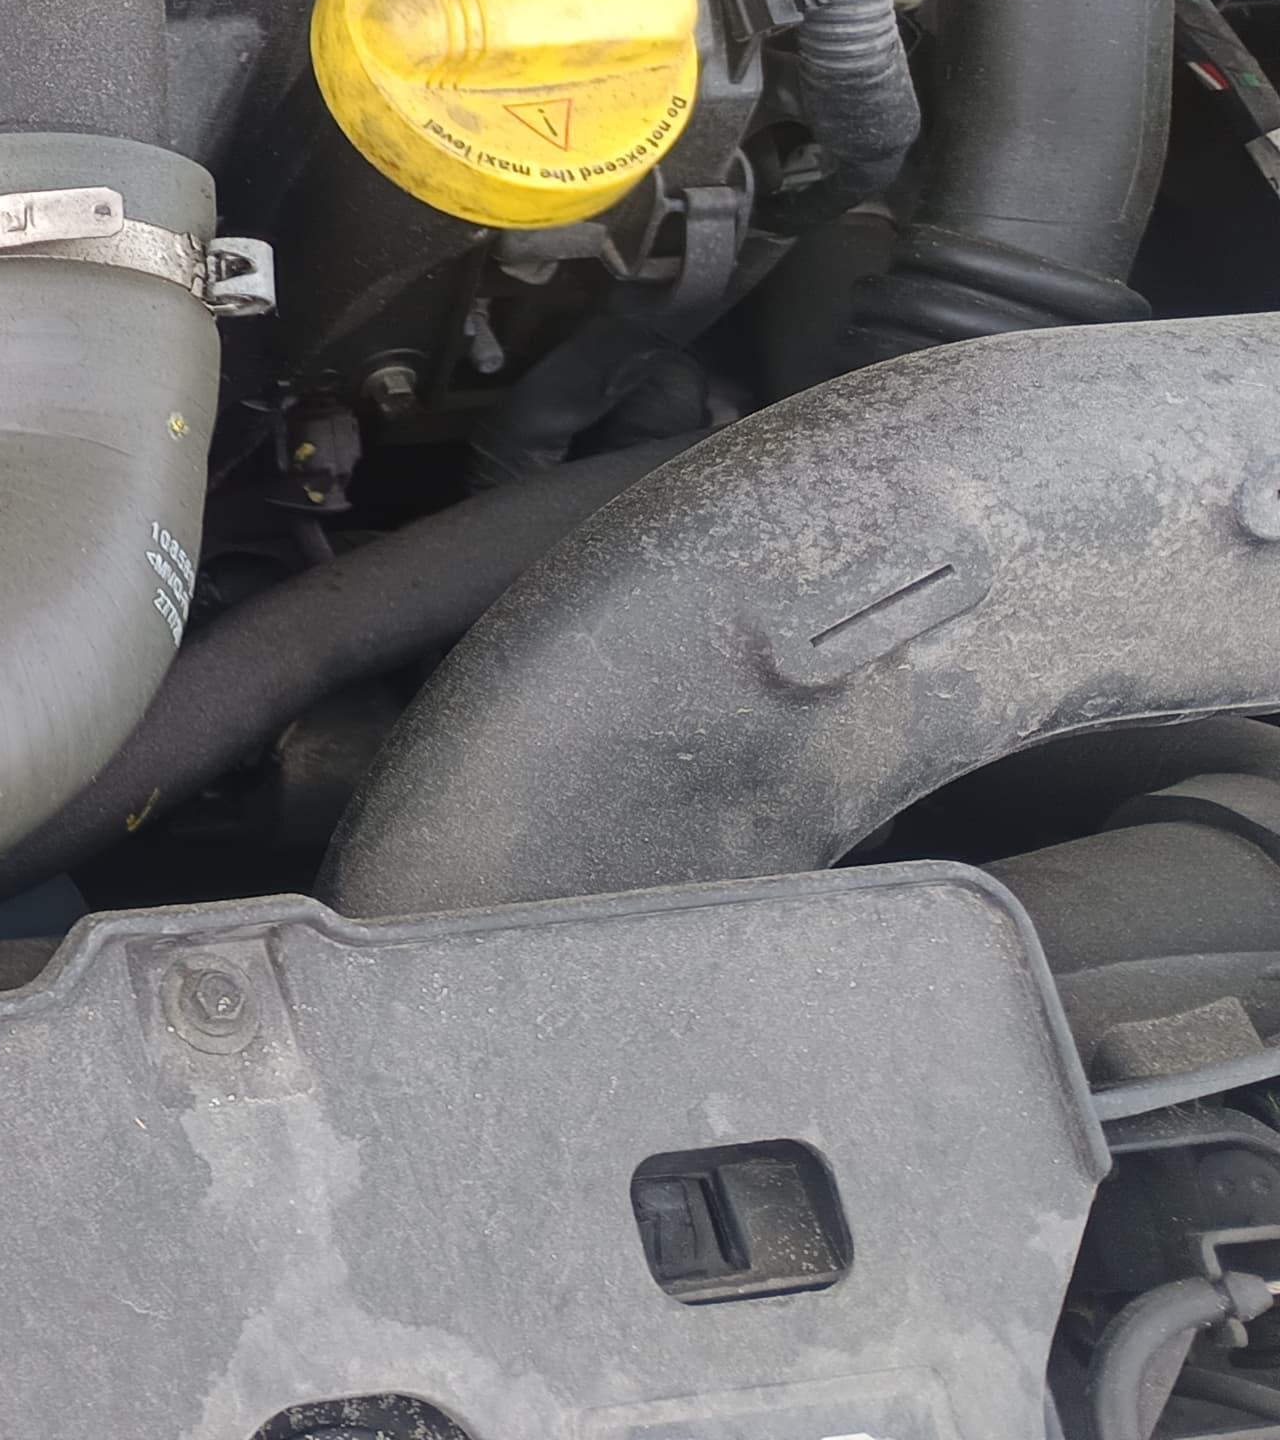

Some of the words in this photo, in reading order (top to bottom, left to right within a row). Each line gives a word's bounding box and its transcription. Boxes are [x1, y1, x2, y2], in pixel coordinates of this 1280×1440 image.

[667, 95, 688, 120] Do
[422, 118, 474, 160] level
[649, 117, 673, 151] not
[473, 151, 532, 178] maxi
[539, 165, 576, 183] the
[580, 144, 648, 182] exceed
